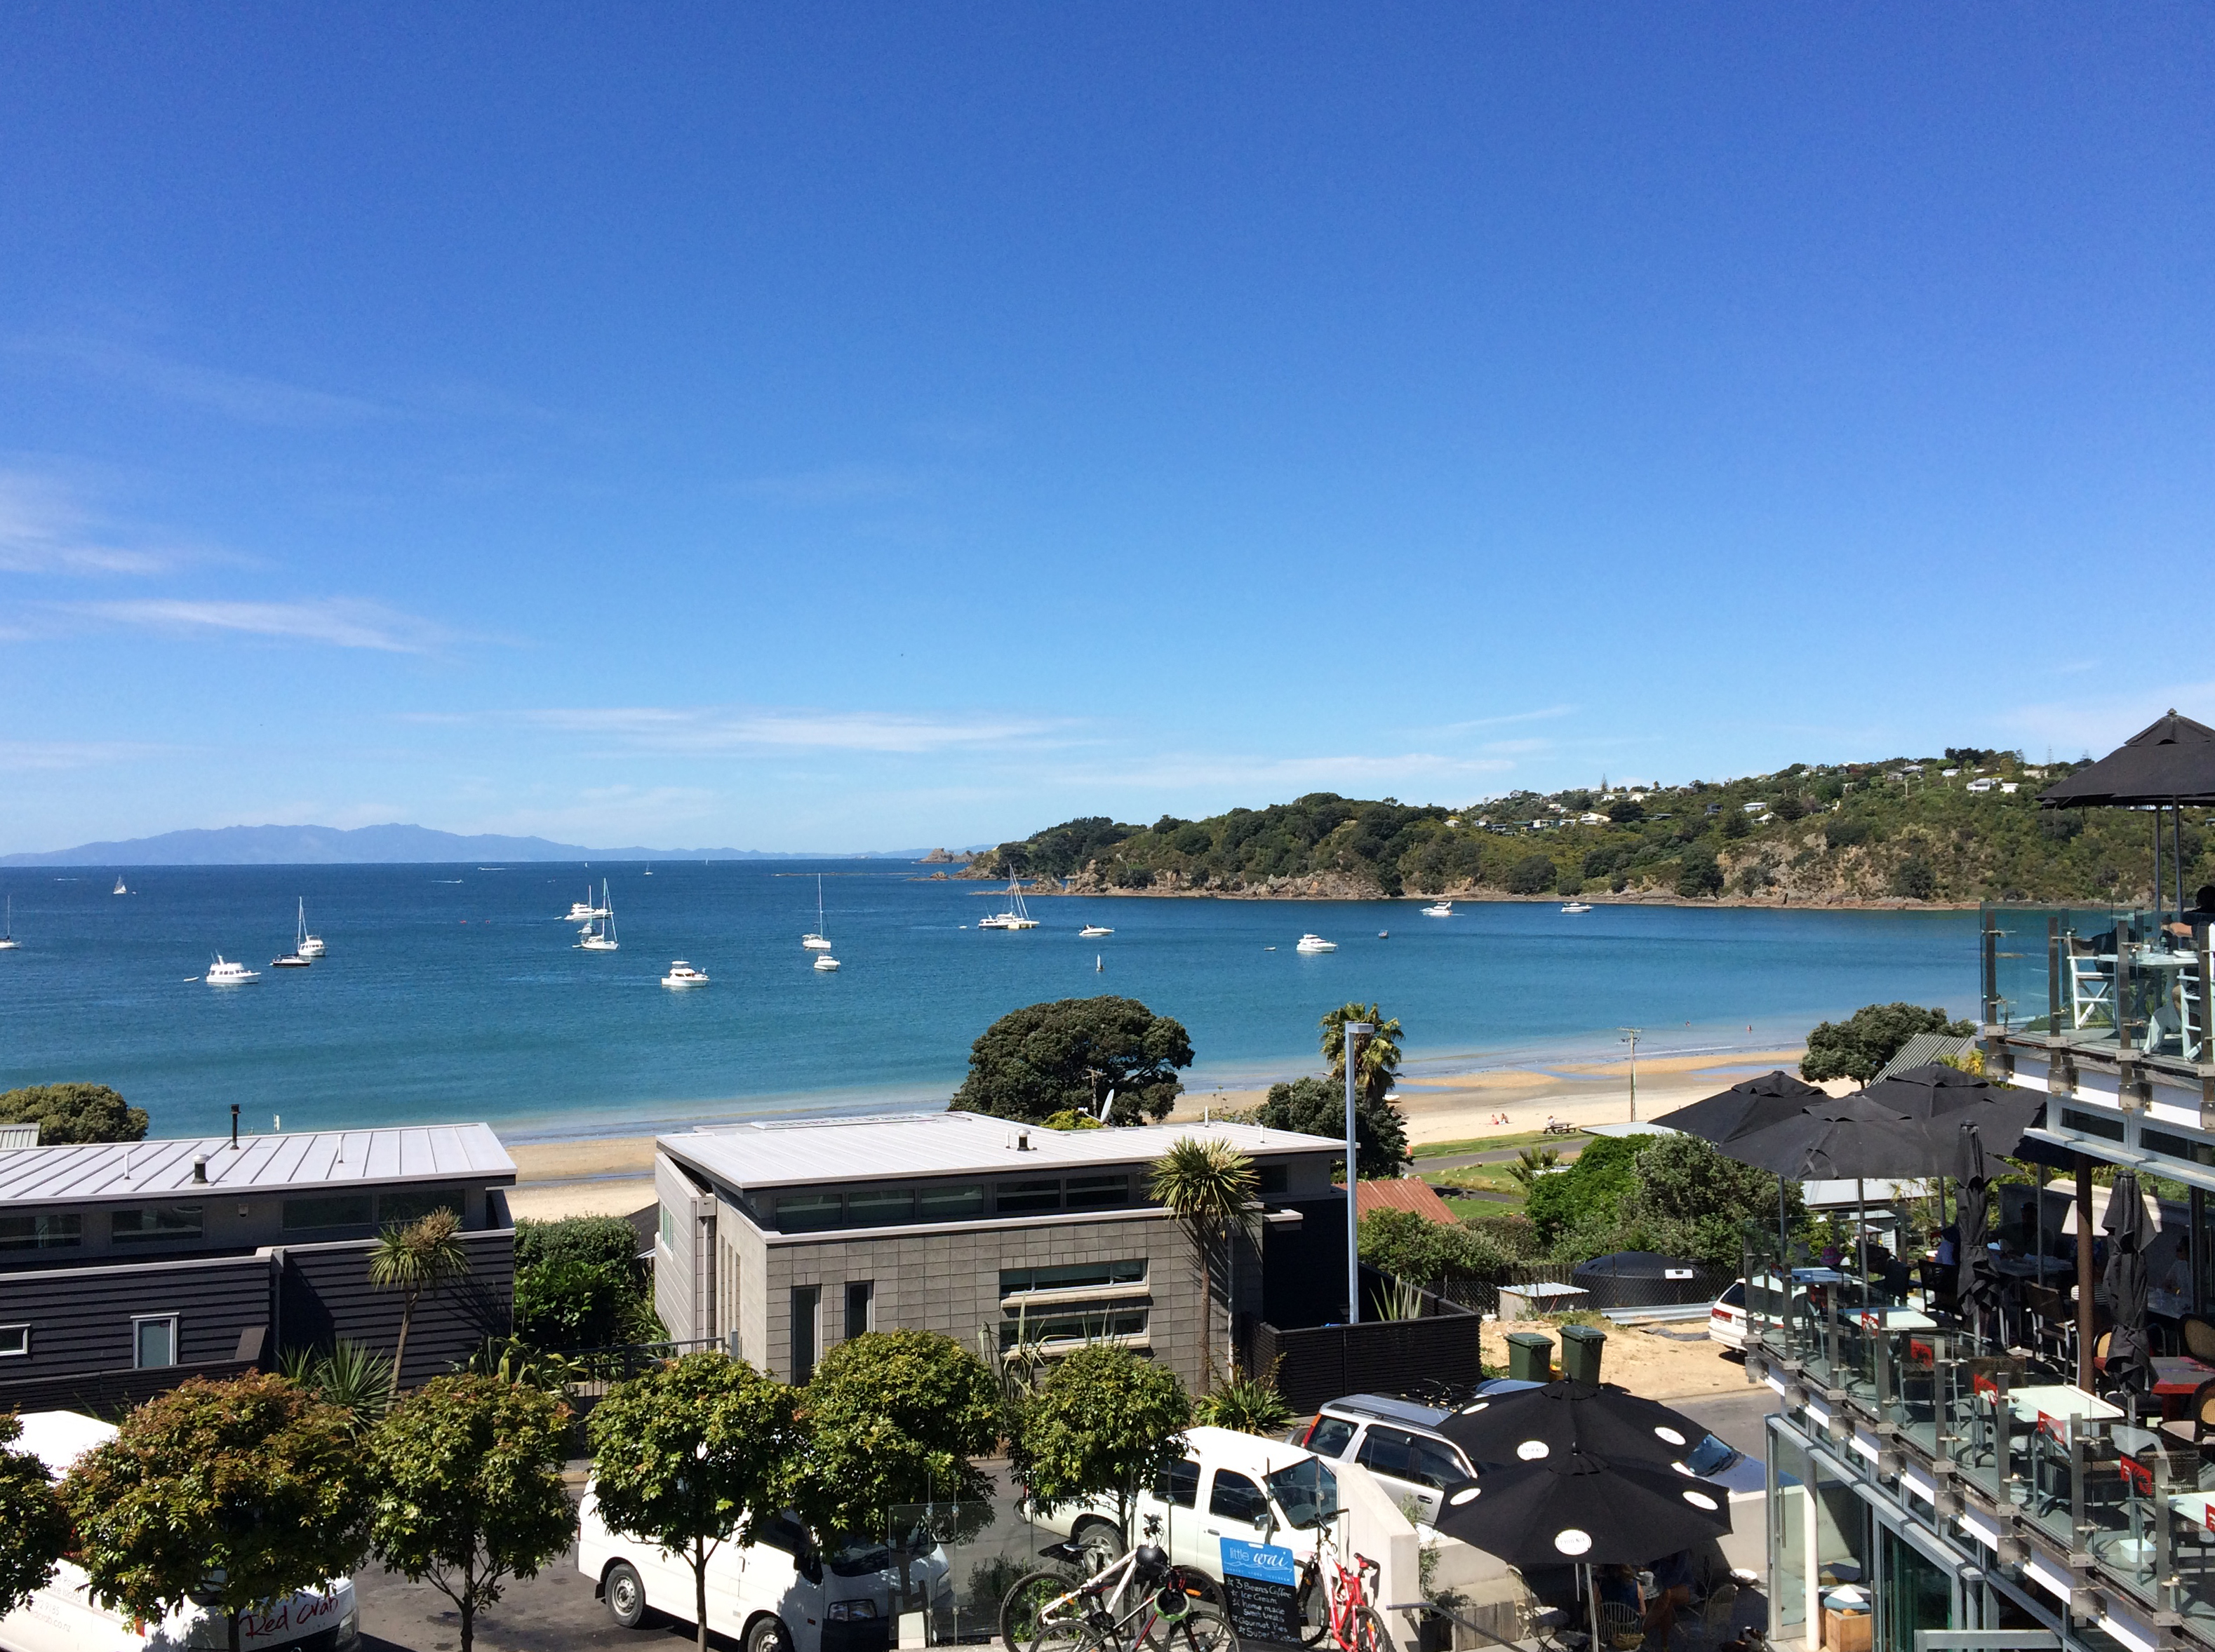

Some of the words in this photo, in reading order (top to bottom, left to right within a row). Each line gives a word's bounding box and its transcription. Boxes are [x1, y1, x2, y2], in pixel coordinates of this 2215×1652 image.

[1230, 1547, 1250, 1562] little
[1253, 1551, 1288, 1566] wai
[1236, 1578, 1243, 1589] 3
[1244, 1582, 1269, 1594] Beans
[1269, 1585, 1292, 1599] Coffee
[1240, 1590, 1252, 1599] Ice
[1253, 1593, 1278, 1605] Cream
[1264, 1606, 1285, 1615] made
[239, 1605, 289, 1640] Red
[1238, 1617, 1270, 1629] Gourmet
[1246, 1627, 1270, 1639] Super
